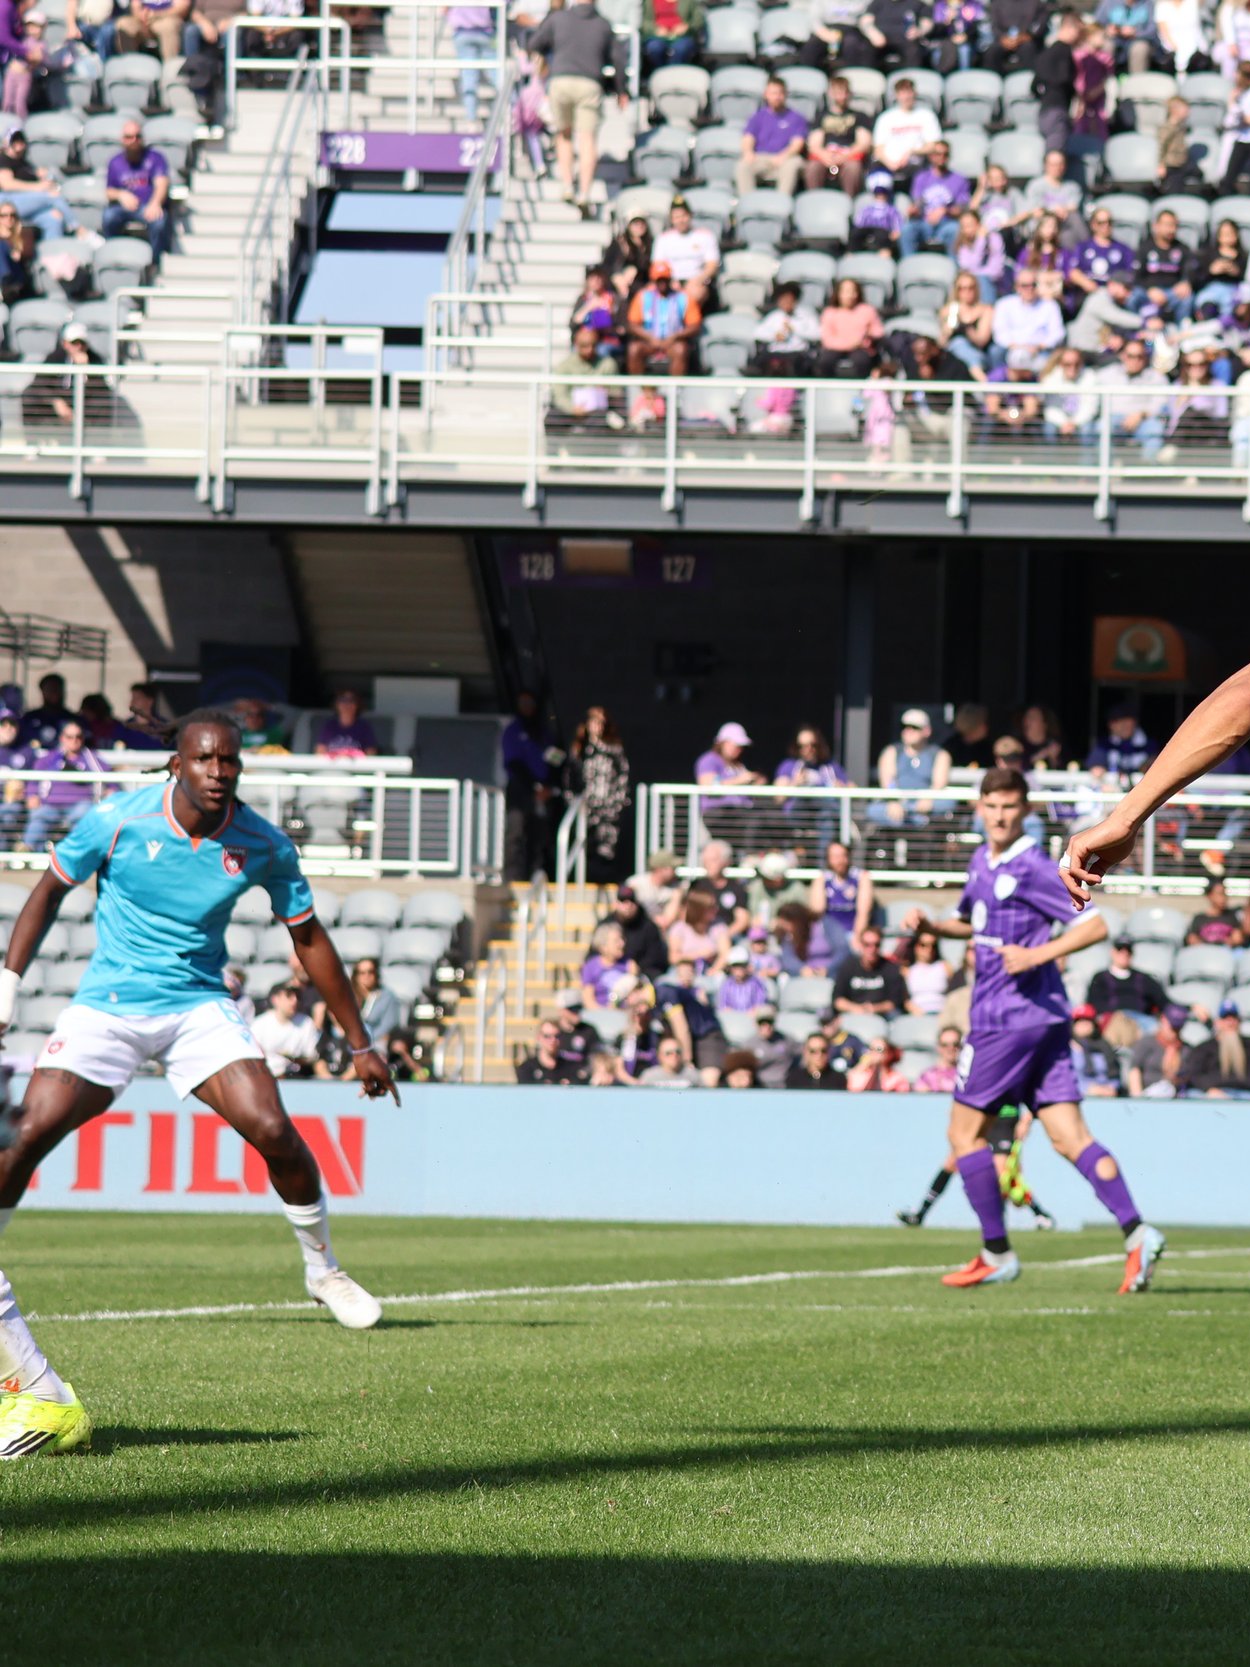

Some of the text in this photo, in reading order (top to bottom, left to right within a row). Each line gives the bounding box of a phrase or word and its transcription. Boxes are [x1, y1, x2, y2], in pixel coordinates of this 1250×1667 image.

[519, 553, 696, 583] 128 127
[28, 1112, 366, 1197] TION
